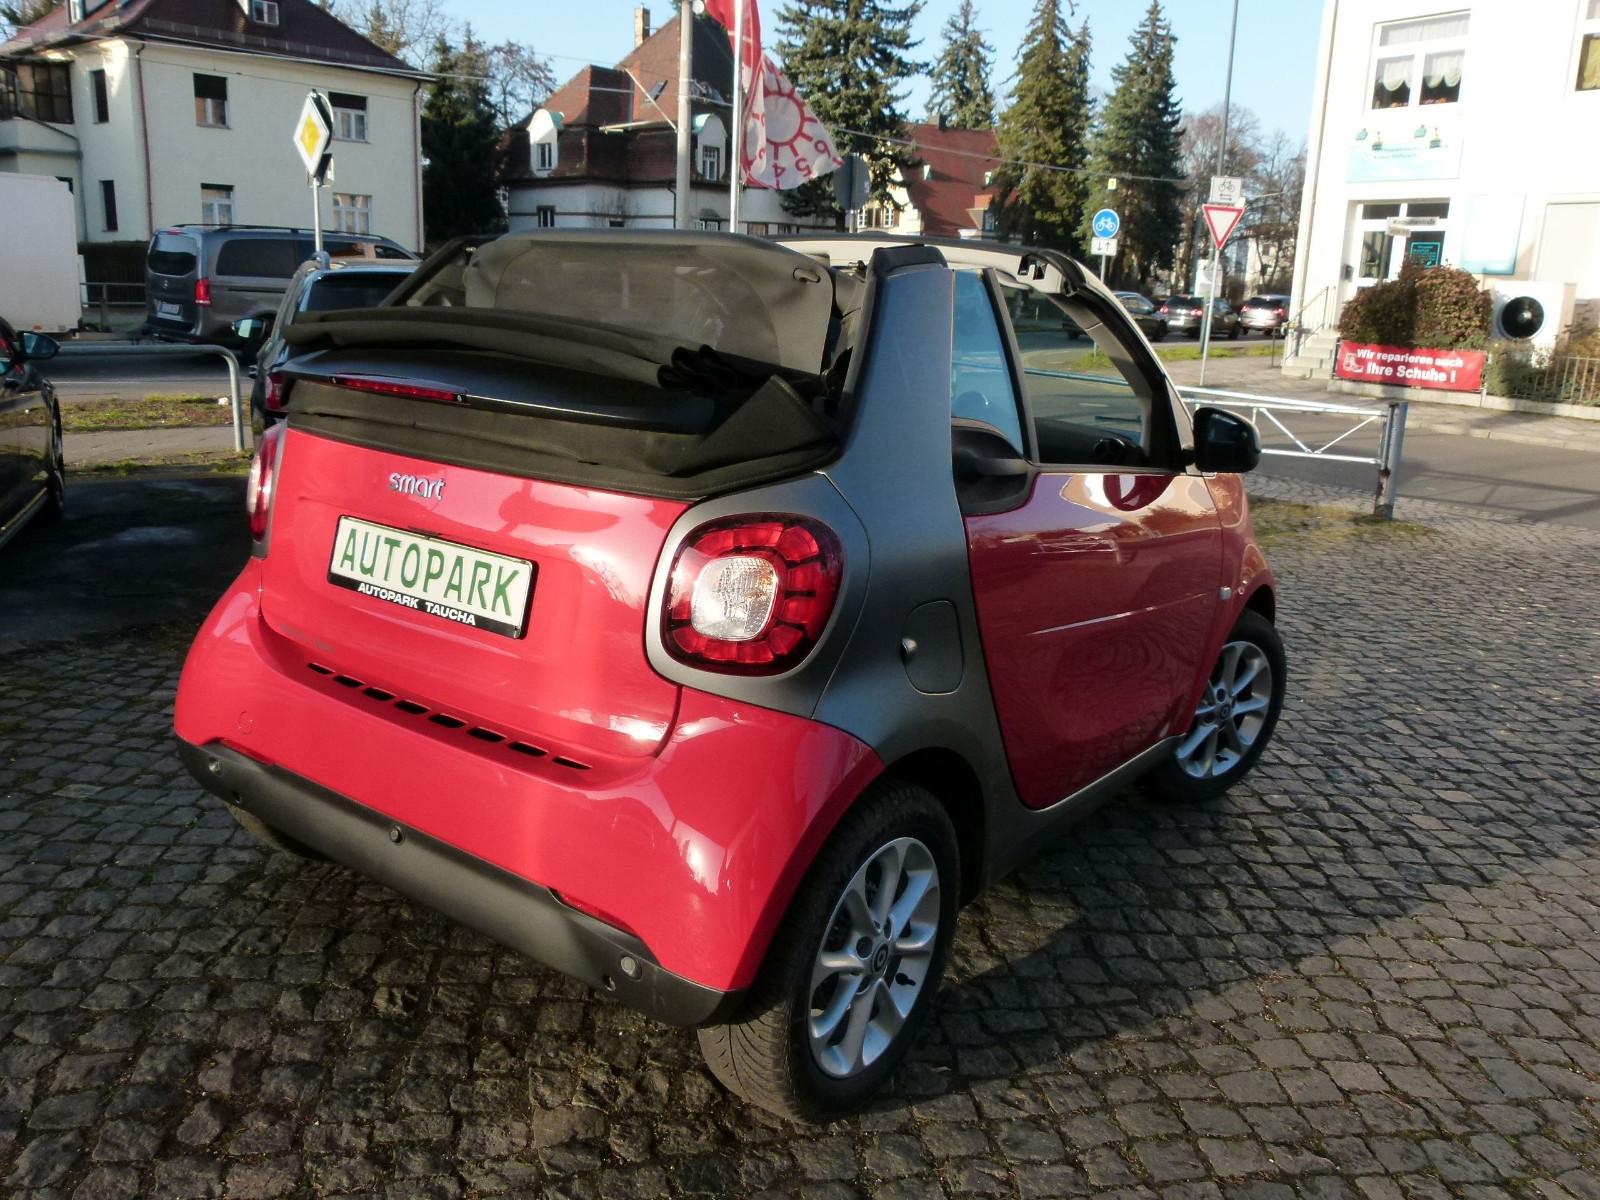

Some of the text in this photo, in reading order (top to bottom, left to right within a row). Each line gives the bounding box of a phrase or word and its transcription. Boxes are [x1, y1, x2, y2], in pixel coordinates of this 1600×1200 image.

[1357, 349, 1463, 367] Wir reparieren auch
[1366, 362, 1393, 376] Ihre
[1397, 366, 1447, 382] Schuhe
[388, 471, 446, 500] smart
[339, 528, 519, 617] AUTOPARK
[357, 582, 476, 626] AUTOPARK TAUCHA
